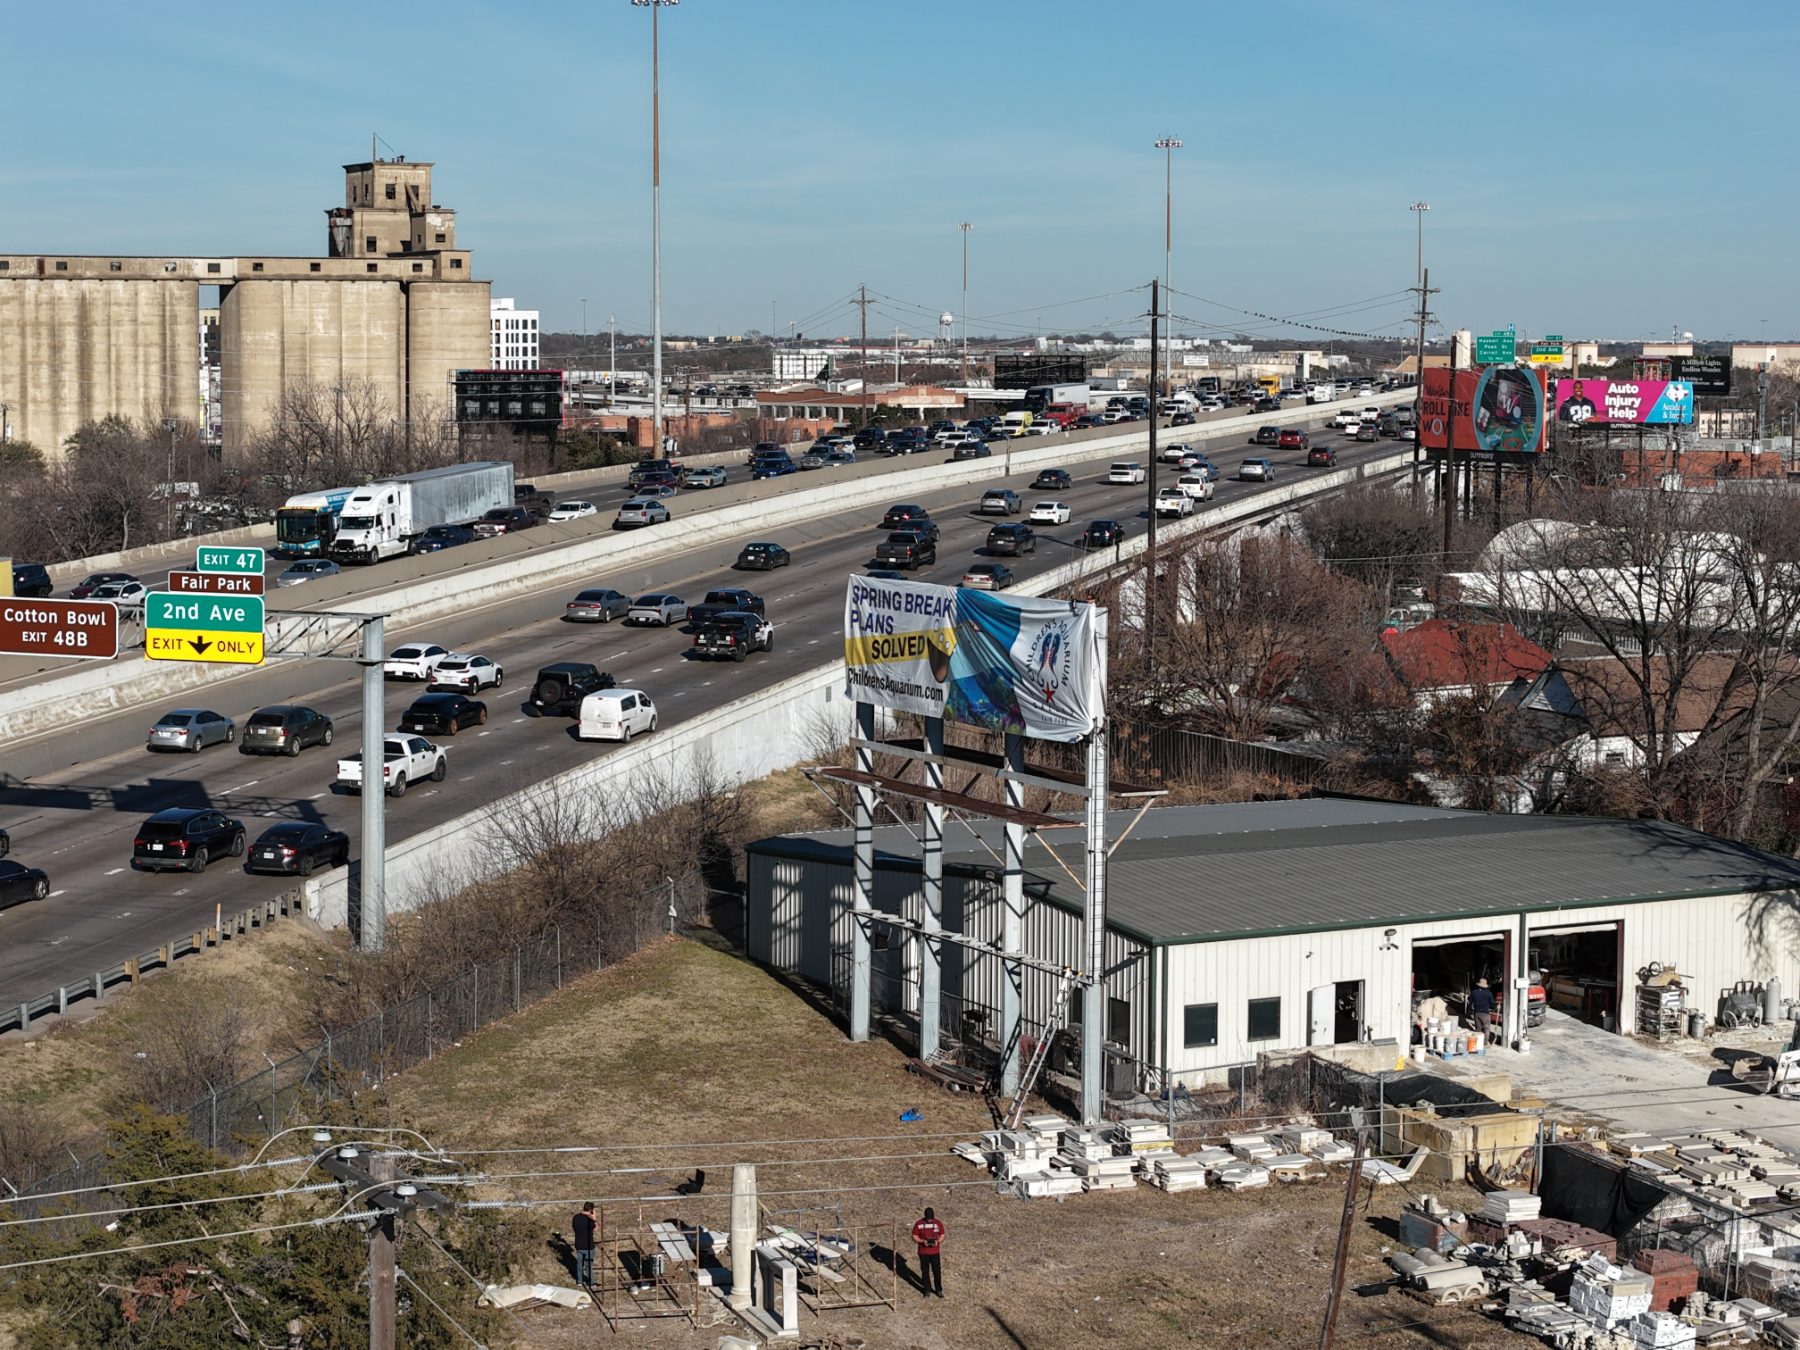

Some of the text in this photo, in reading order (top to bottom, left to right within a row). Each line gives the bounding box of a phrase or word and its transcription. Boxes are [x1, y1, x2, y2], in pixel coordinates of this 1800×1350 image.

[1608, 383, 1639, 394] Auto
[1423, 401, 1446, 416] ROLL
[1605, 395, 1641, 408] Injury
[1608, 408, 1638, 420] Help
[203, 553, 257, 569] EXIT 47
[181, 576, 251, 591] Fair Park
[852, 585, 953, 618] SPRING BREAK
[4, 608, 107, 626] Cotton Bowl
[162, 602, 246, 622] 2nd Ave
[850, 609, 894, 635] PLANS
[22, 630, 88, 647] EXIT 48B
[152, 637, 256, 654] EXIT ONLY
[871, 635, 926, 660] SOLVED
[847, 667, 944, 702] ChildrensAquarium.com
